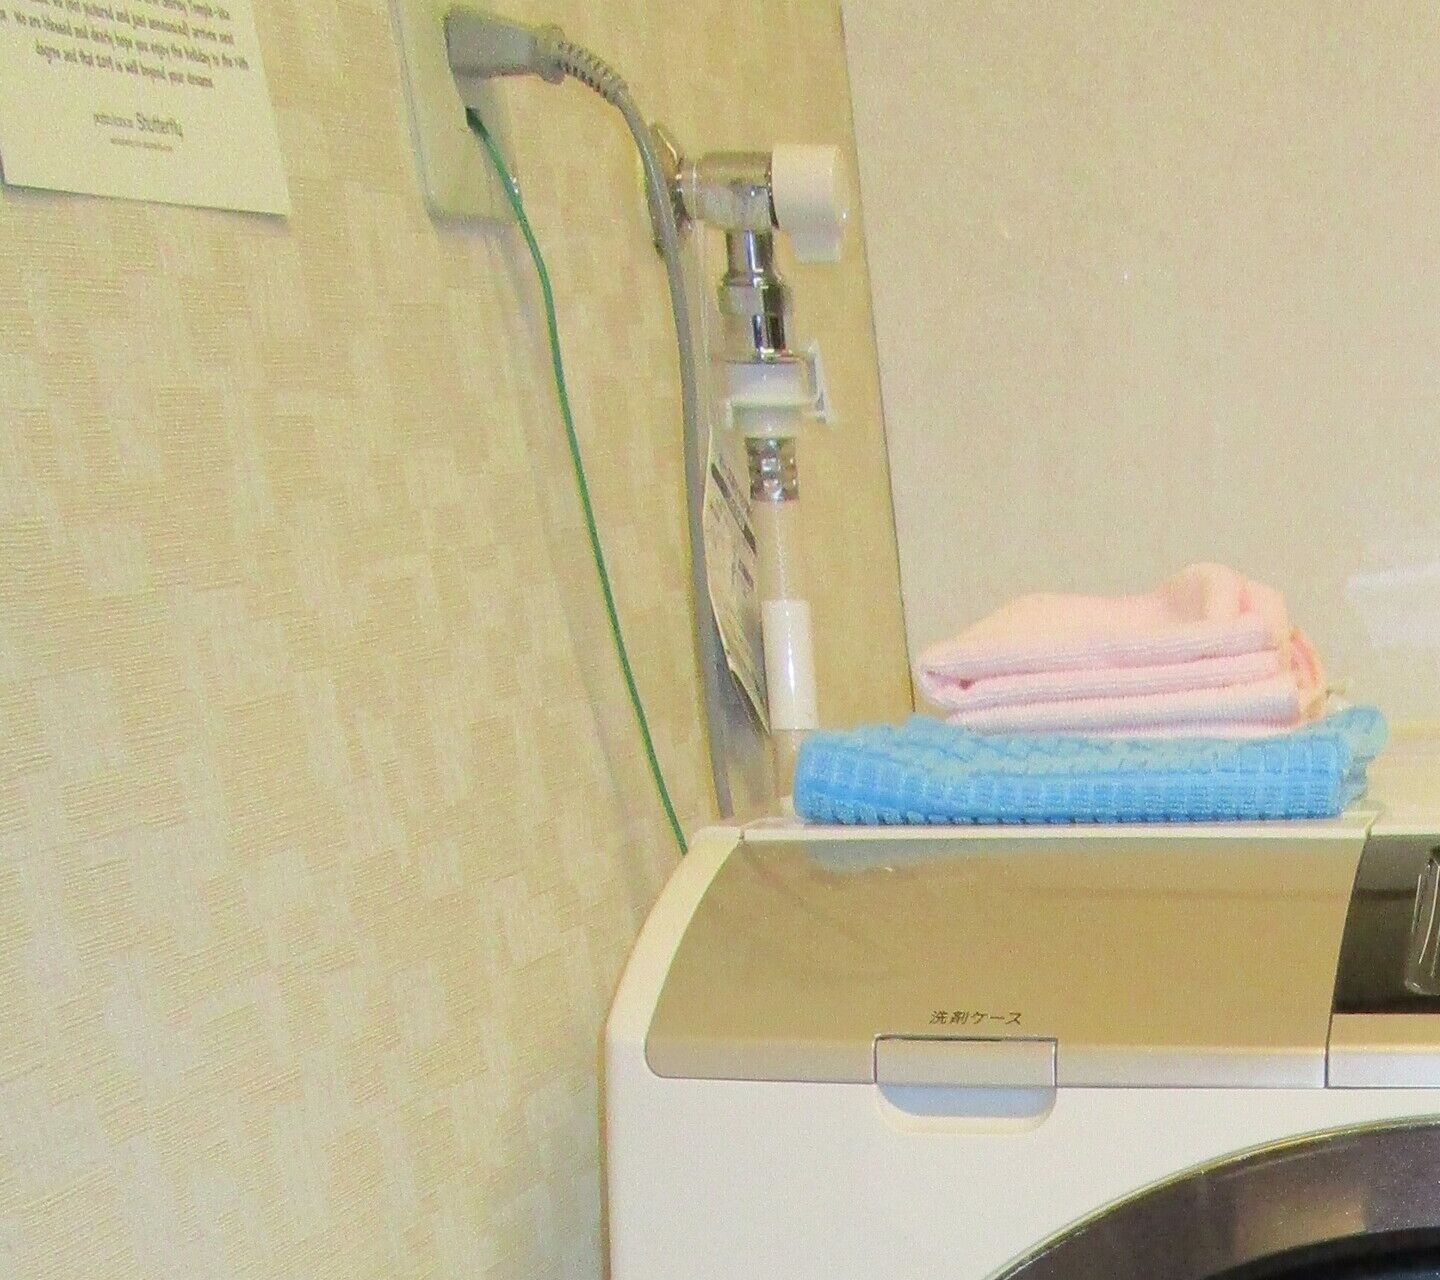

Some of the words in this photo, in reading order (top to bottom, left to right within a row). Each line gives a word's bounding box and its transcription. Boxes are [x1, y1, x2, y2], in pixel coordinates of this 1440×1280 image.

[929, 1009, 1023, 1026] 洗剤ケース
